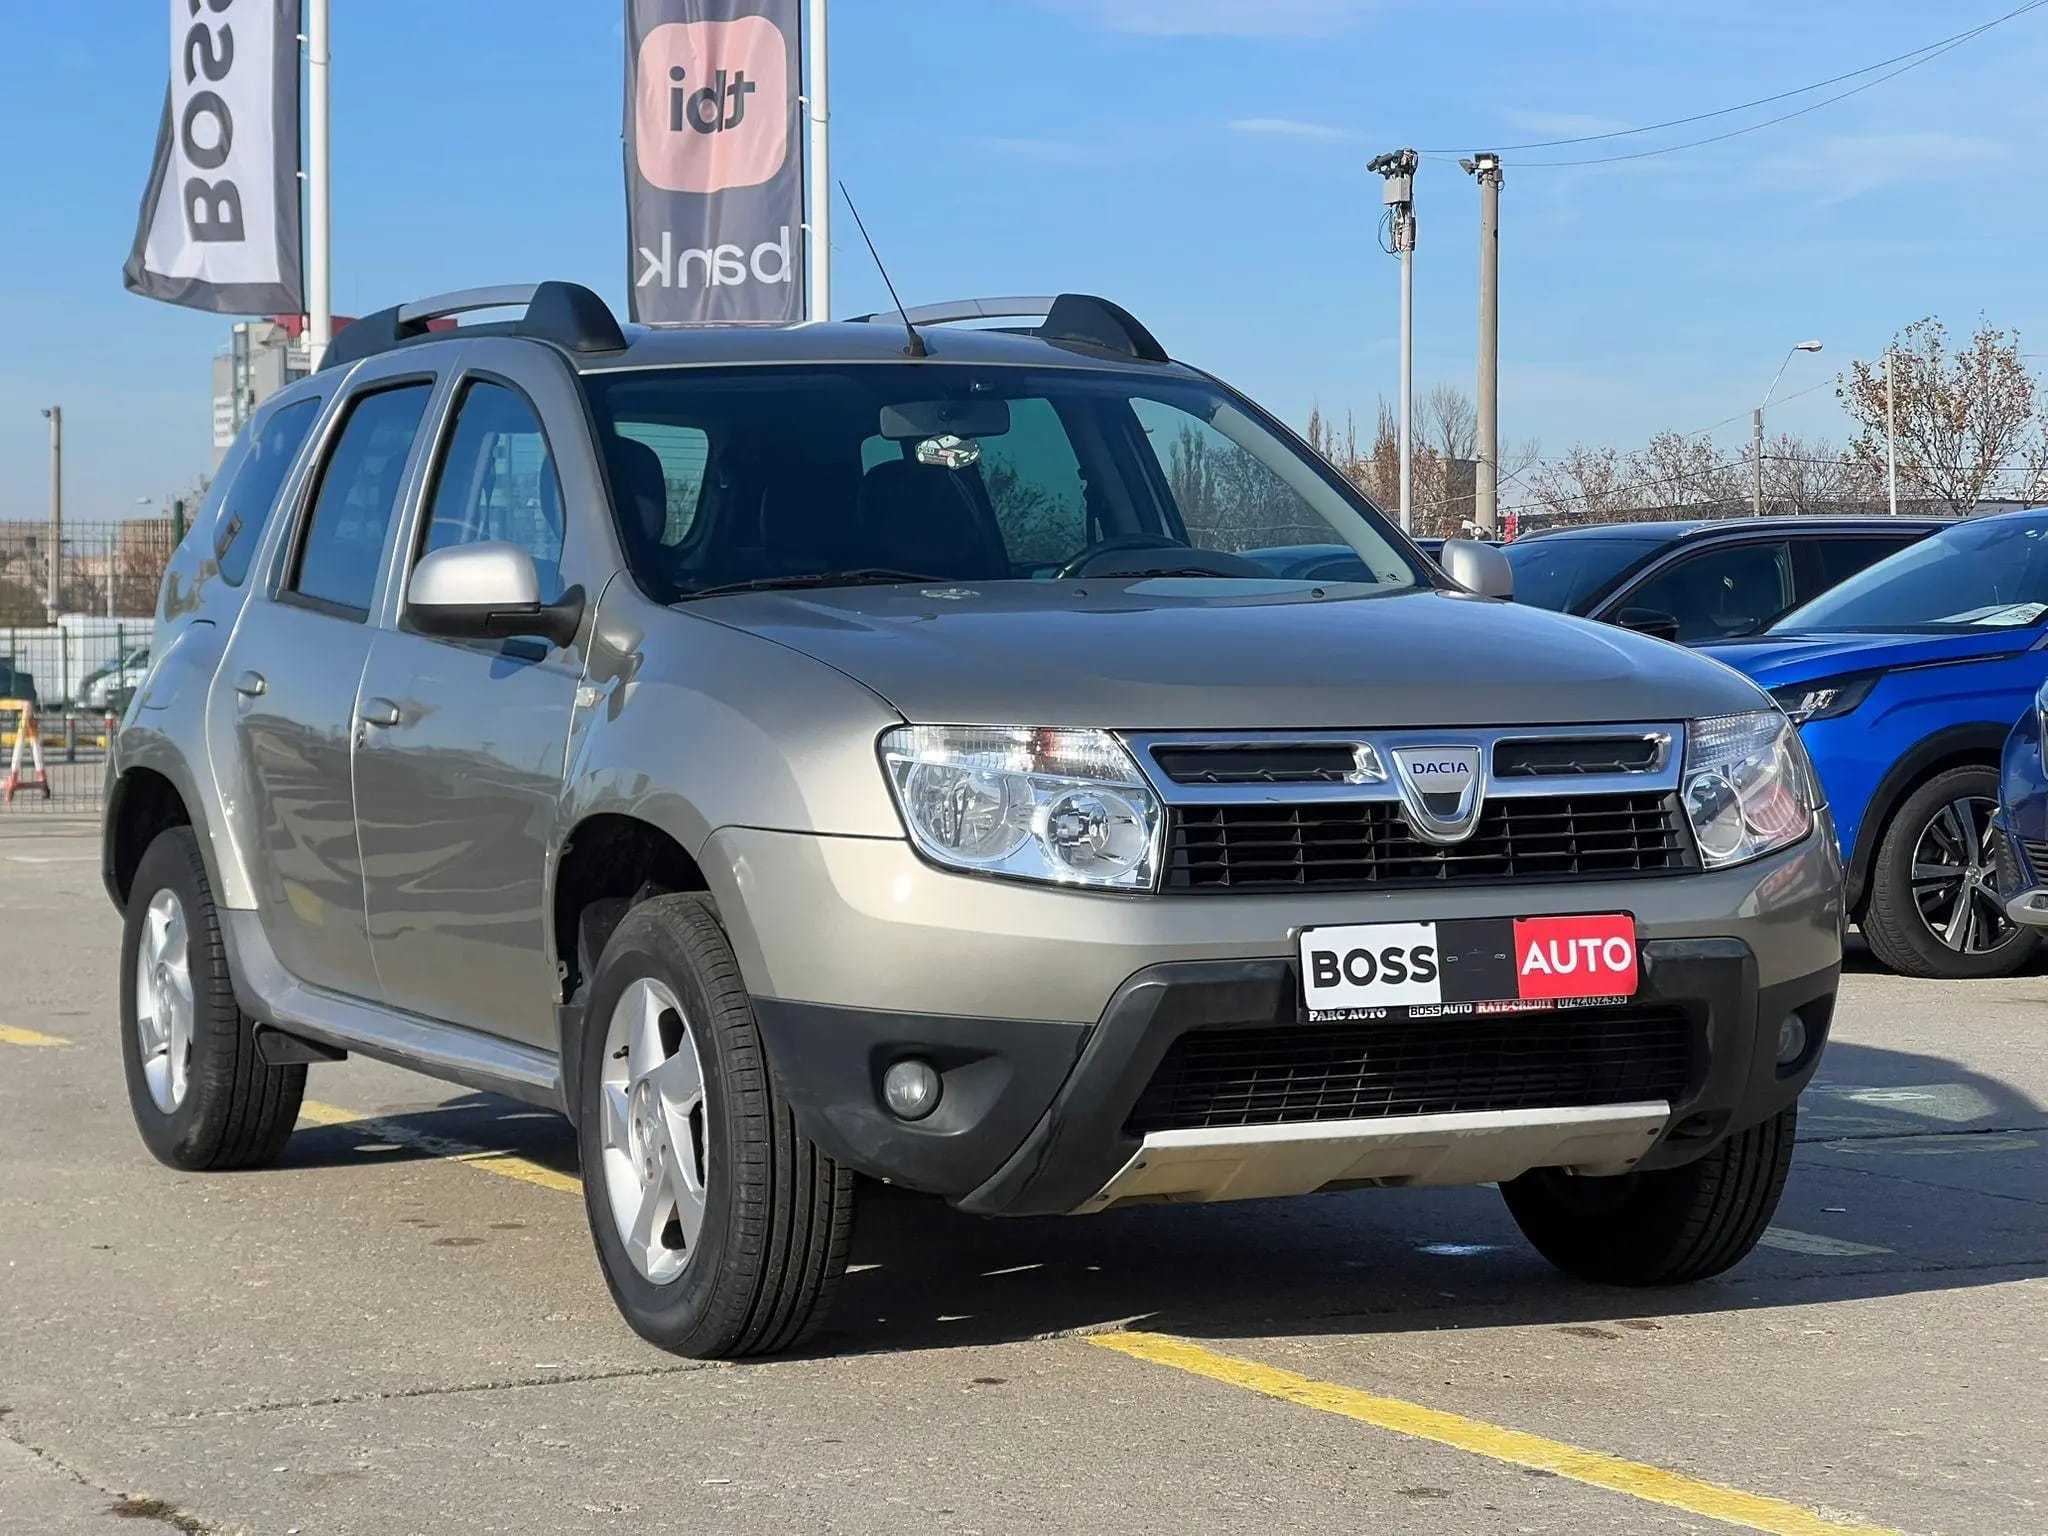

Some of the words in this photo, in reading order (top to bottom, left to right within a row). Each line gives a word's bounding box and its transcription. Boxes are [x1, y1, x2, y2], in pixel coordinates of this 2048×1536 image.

[1412, 762, 1469, 774] DACIA
[1311, 945, 1440, 989] BOSS
[1521, 936, 1633, 976] AUTO
[1308, 1009, 1346, 1021] PARC
[1349, 1007, 1387, 1020] AUTO
[1410, 1005, 1441, 1016] BOSS
[1442, 1003, 1473, 1015] AUTO
